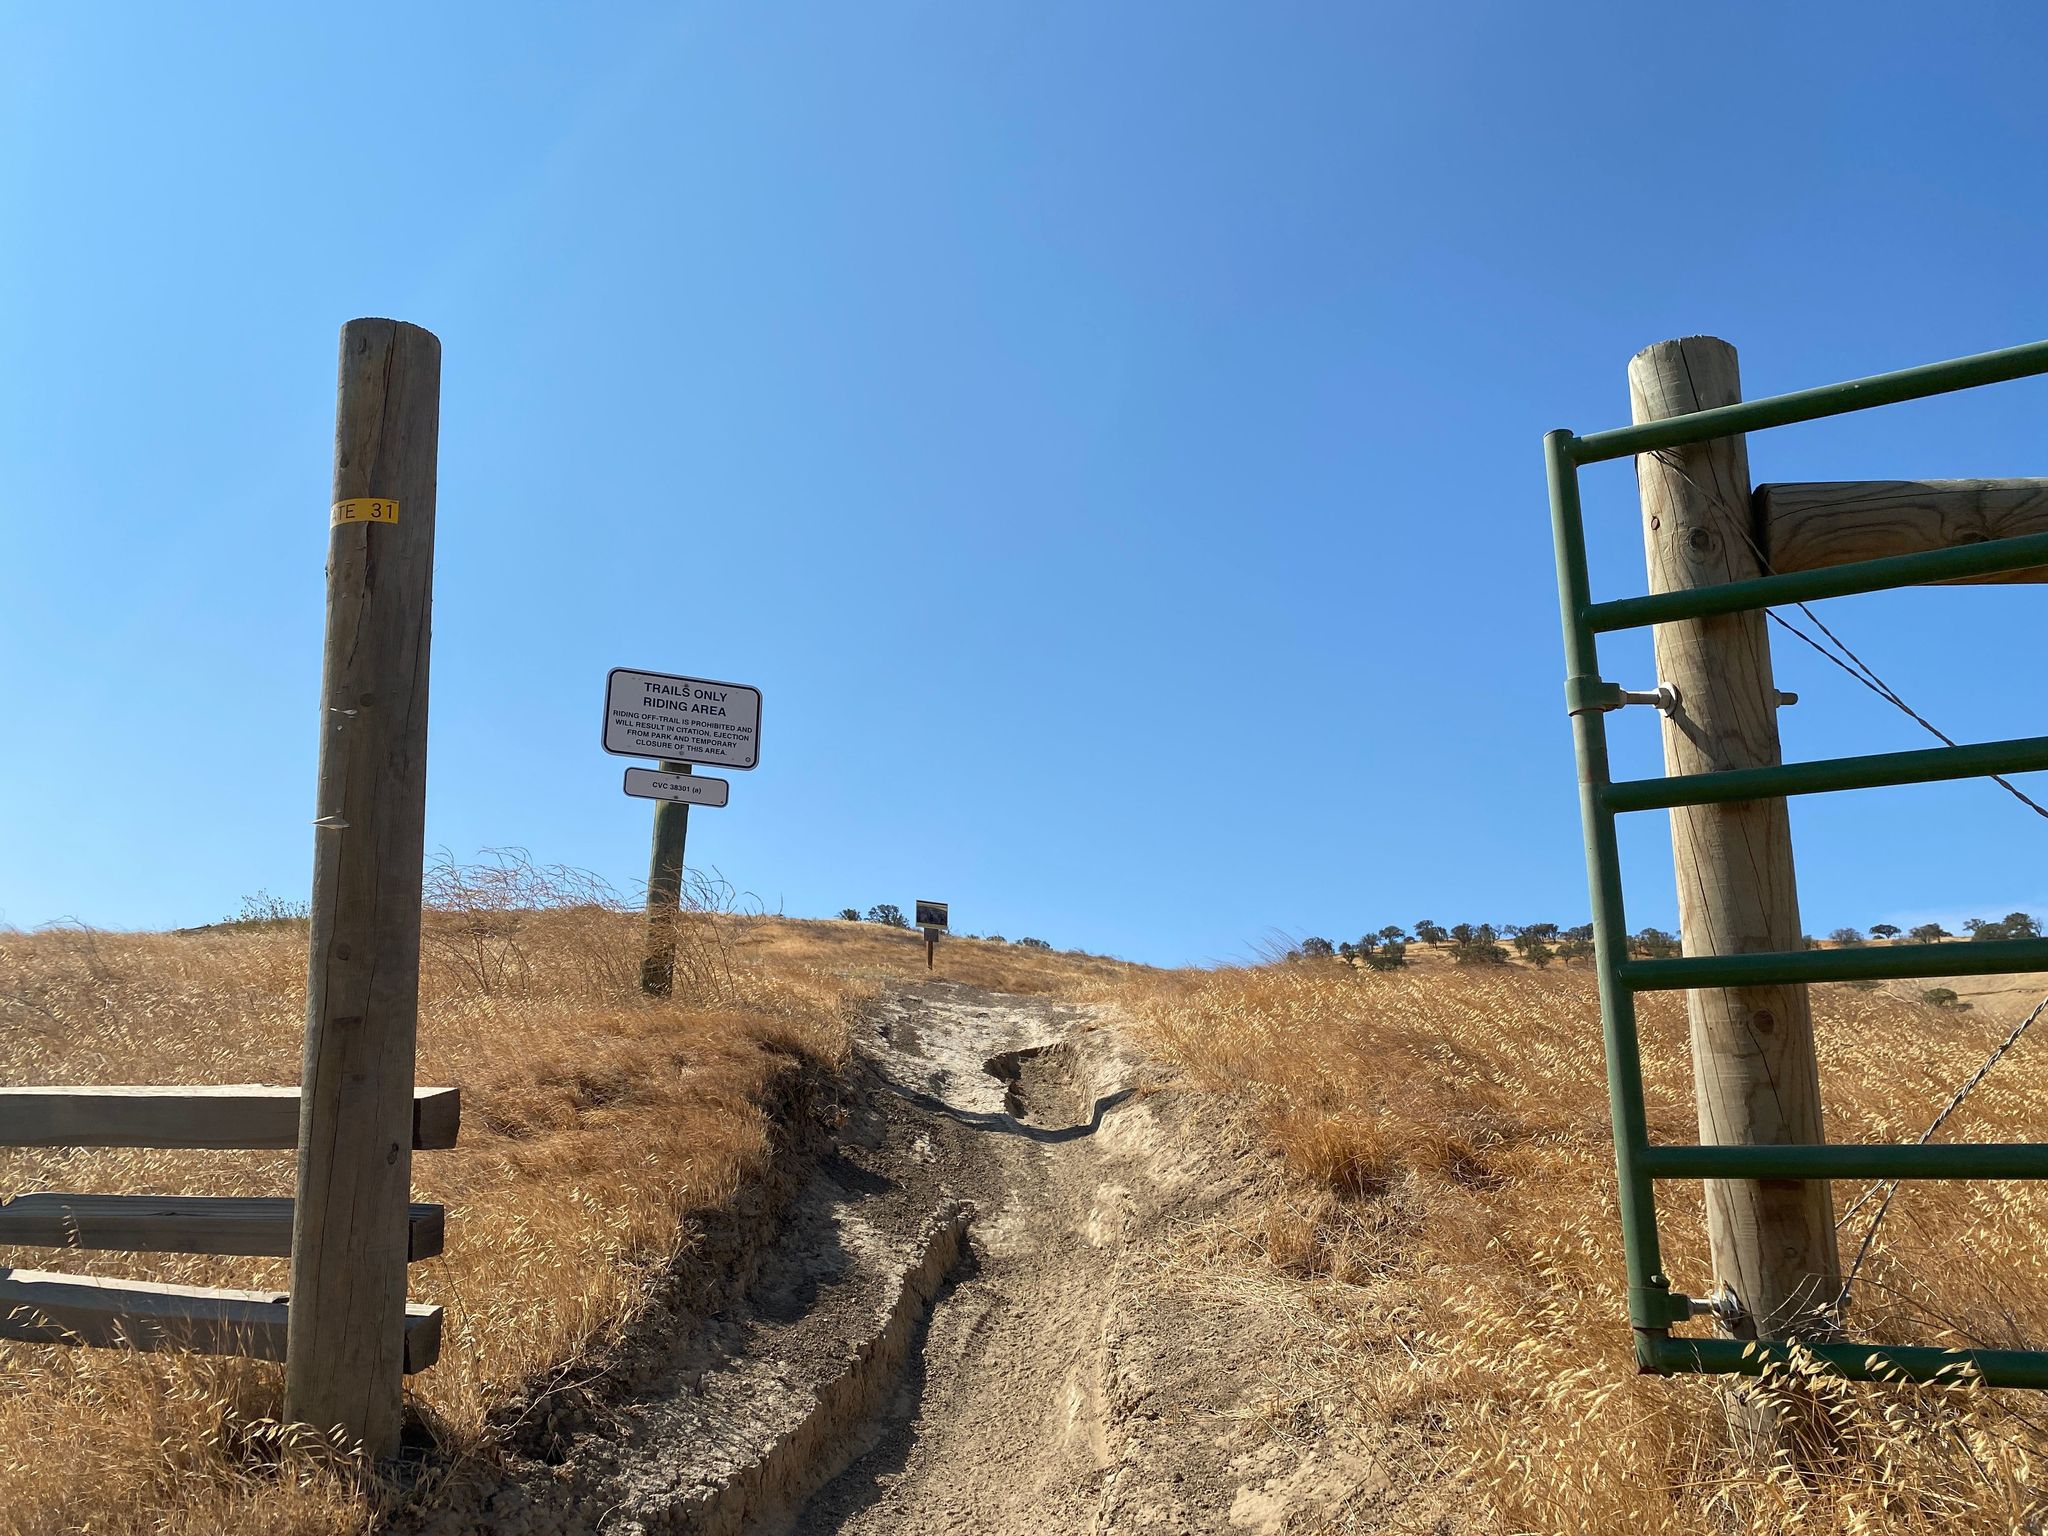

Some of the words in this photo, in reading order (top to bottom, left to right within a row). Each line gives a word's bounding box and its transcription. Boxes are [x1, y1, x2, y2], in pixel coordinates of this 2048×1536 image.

[371, 503, 392, 518] 31
[644, 682, 690, 697] TRAILS
[694, 689, 727, 702] ONLY
[643, 697, 687, 711] RIDING
[691, 704, 726, 716] AREA
[613, 710, 639, 719] RIDING
[642, 714, 680, 724] OFF-TRAIL
[691, 720, 735, 731] PROHIBITED
[636, 722, 665, 730] RESULT
[714, 732, 749, 741] EJECTION
[636, 739, 672, 749] CLOSURE
[692, 737, 737, 748] TEMPORARY
